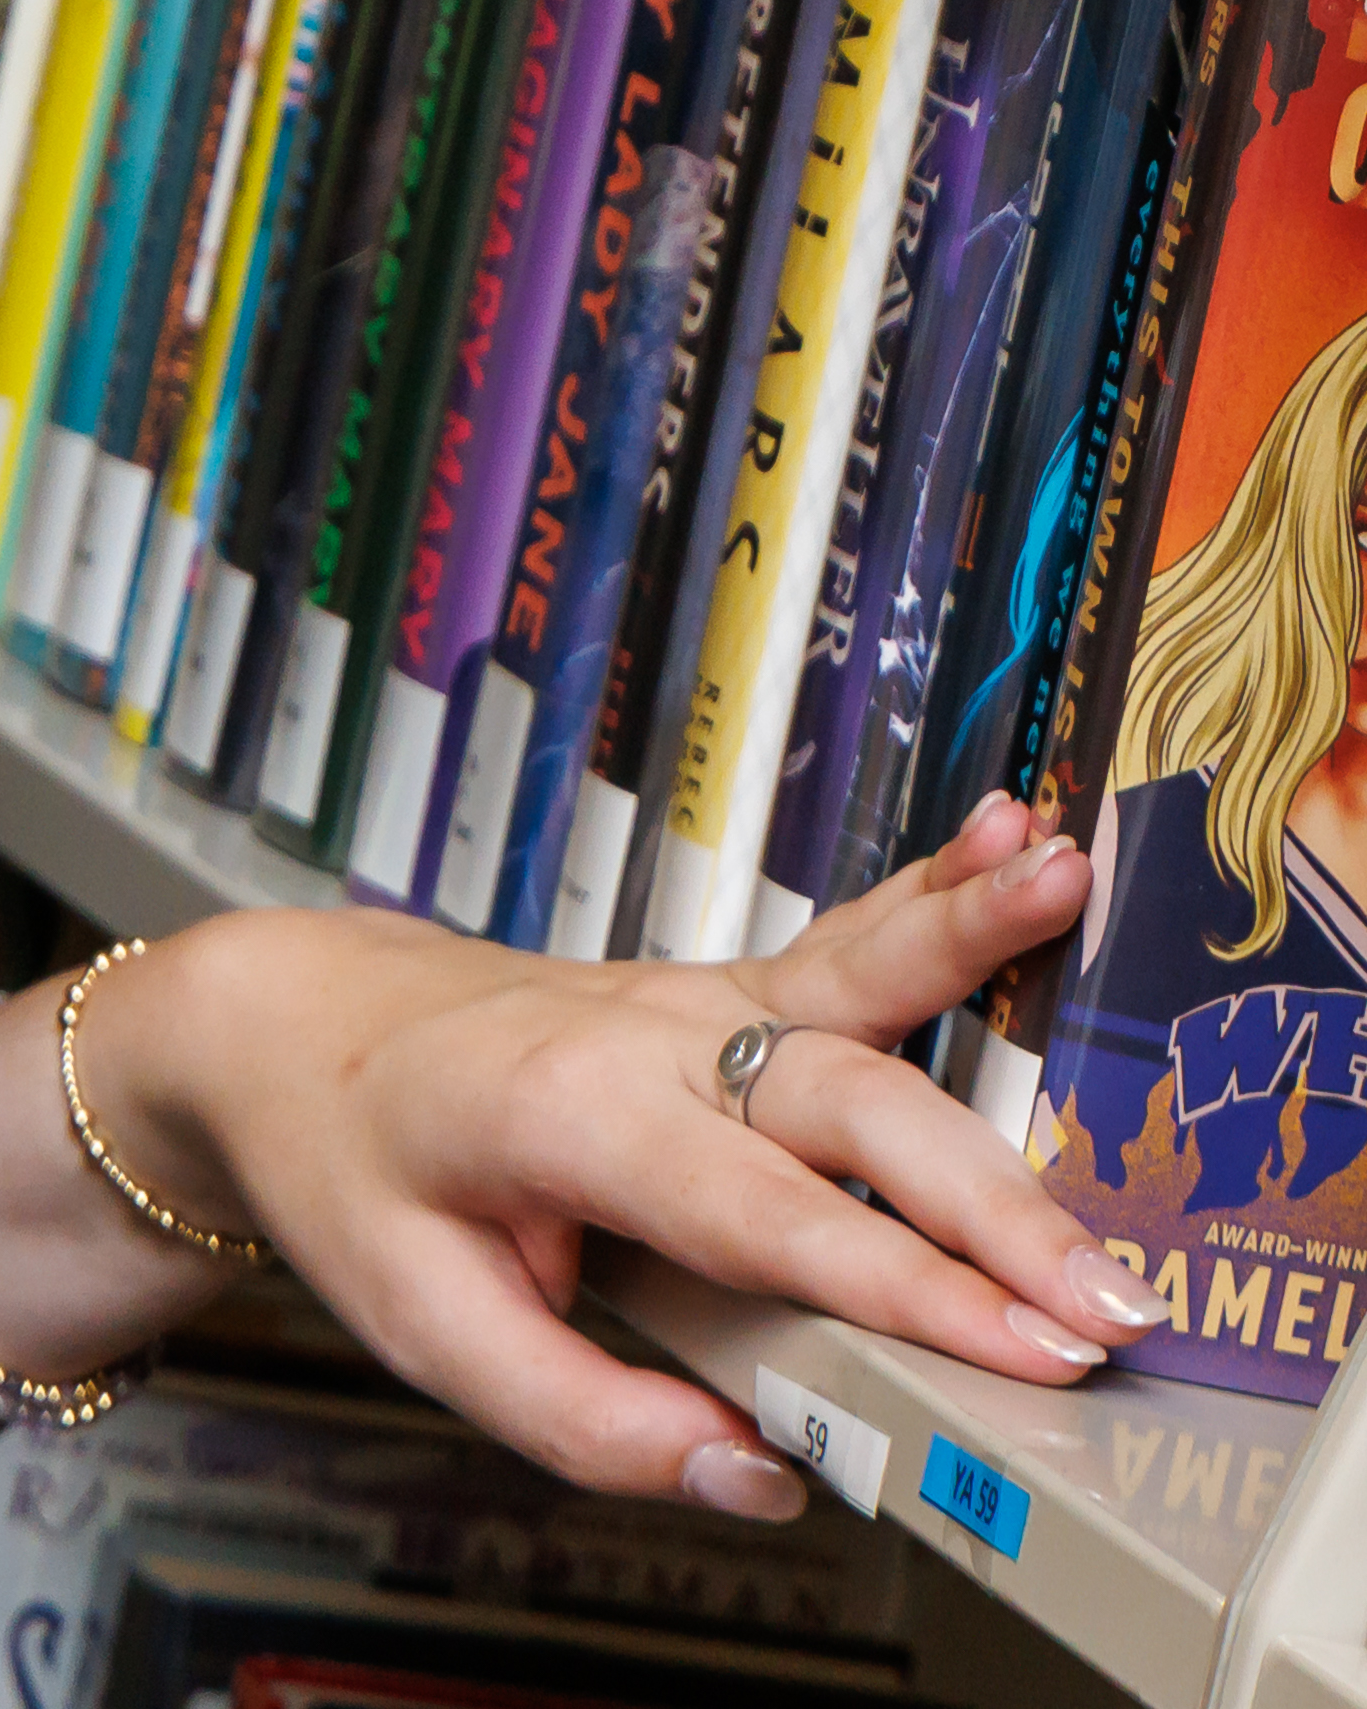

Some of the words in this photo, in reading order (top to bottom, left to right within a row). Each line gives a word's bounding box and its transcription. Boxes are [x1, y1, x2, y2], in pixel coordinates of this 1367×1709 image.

[580, 71, 661, 348] LADY
[1137, 175, 1194, 357] THIS
[1066, 158, 1158, 539] everything
[400, 409, 473, 665] MARY
[505, 372, 587, 653] JANE
[1078, 394, 1146, 635] TOWN
[1048, 564, 1075, 651] we
[1024, 673, 1051, 803] nev
[1054, 661, 1084, 742] IS
[803, 1414, 829, 1464] 59
[953, 1460, 975, 1511] YA
[975, 1477, 999, 1526] 59
